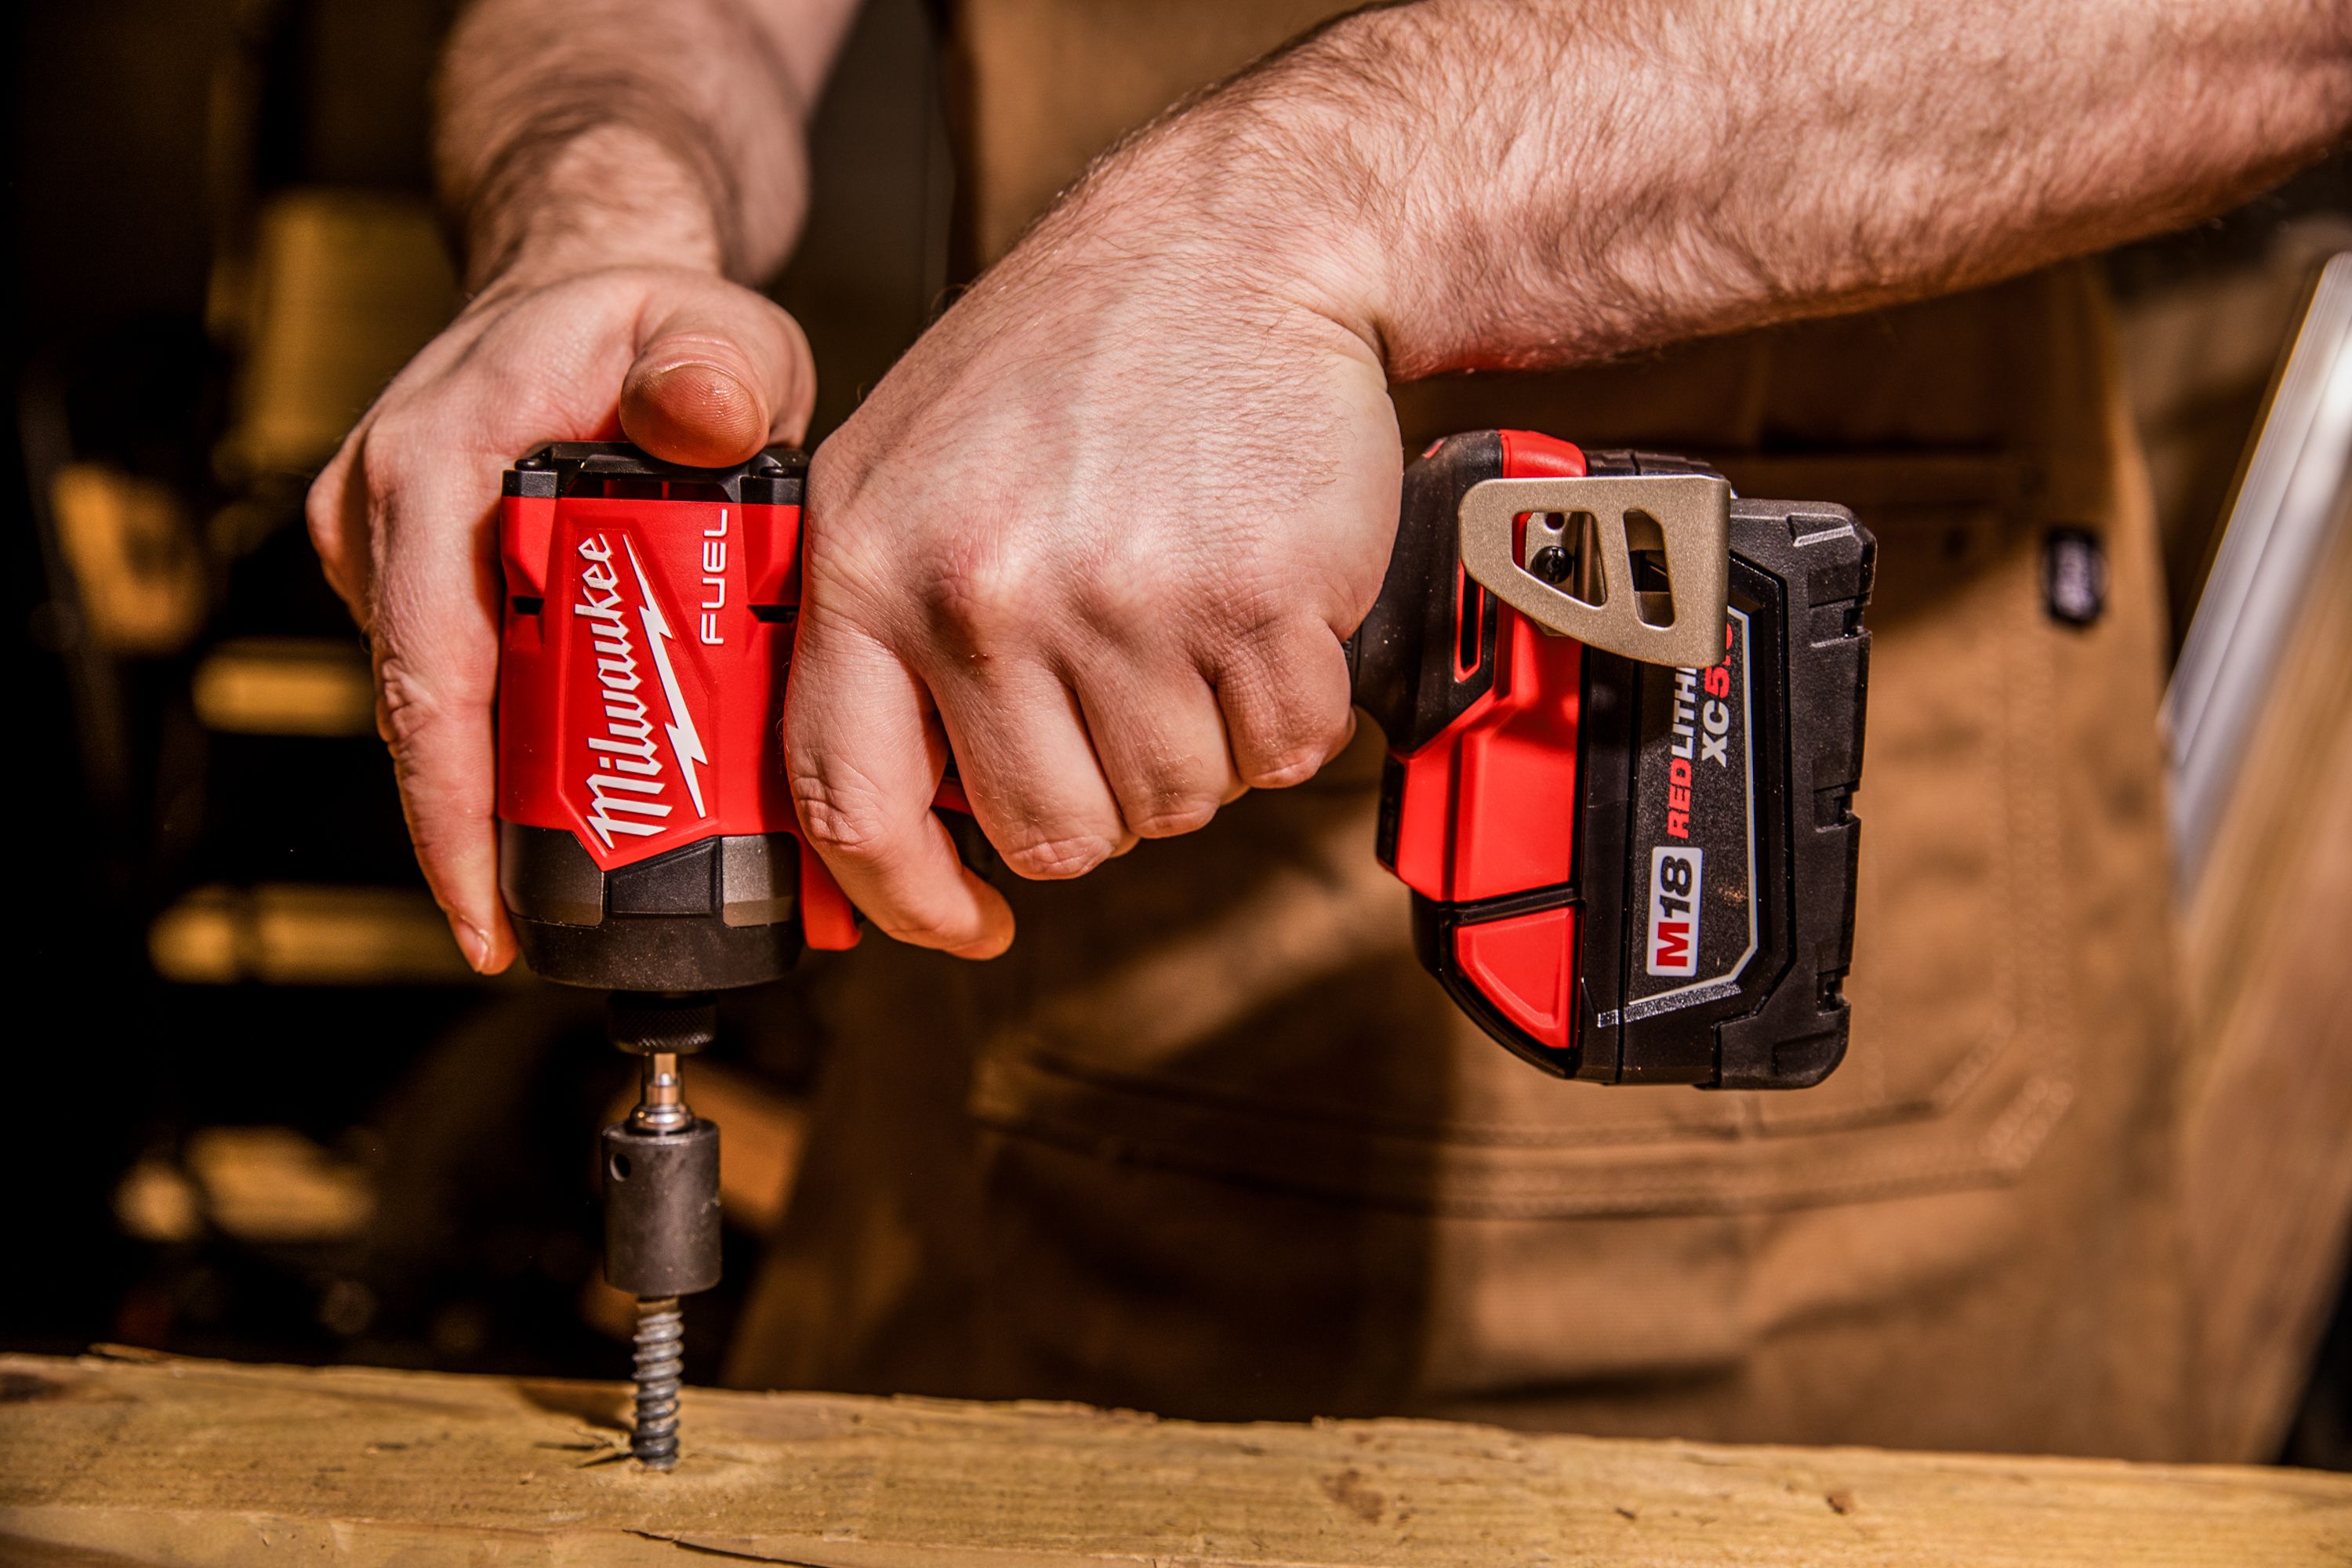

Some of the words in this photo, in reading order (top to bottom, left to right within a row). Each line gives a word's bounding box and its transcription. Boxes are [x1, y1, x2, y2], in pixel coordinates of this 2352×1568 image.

[700, 508, 728, 646] FUEL
[574, 533, 673, 849] Milwaukee
[1700, 623, 1733, 768] XC5.
[1657, 856, 1693, 968] M18
